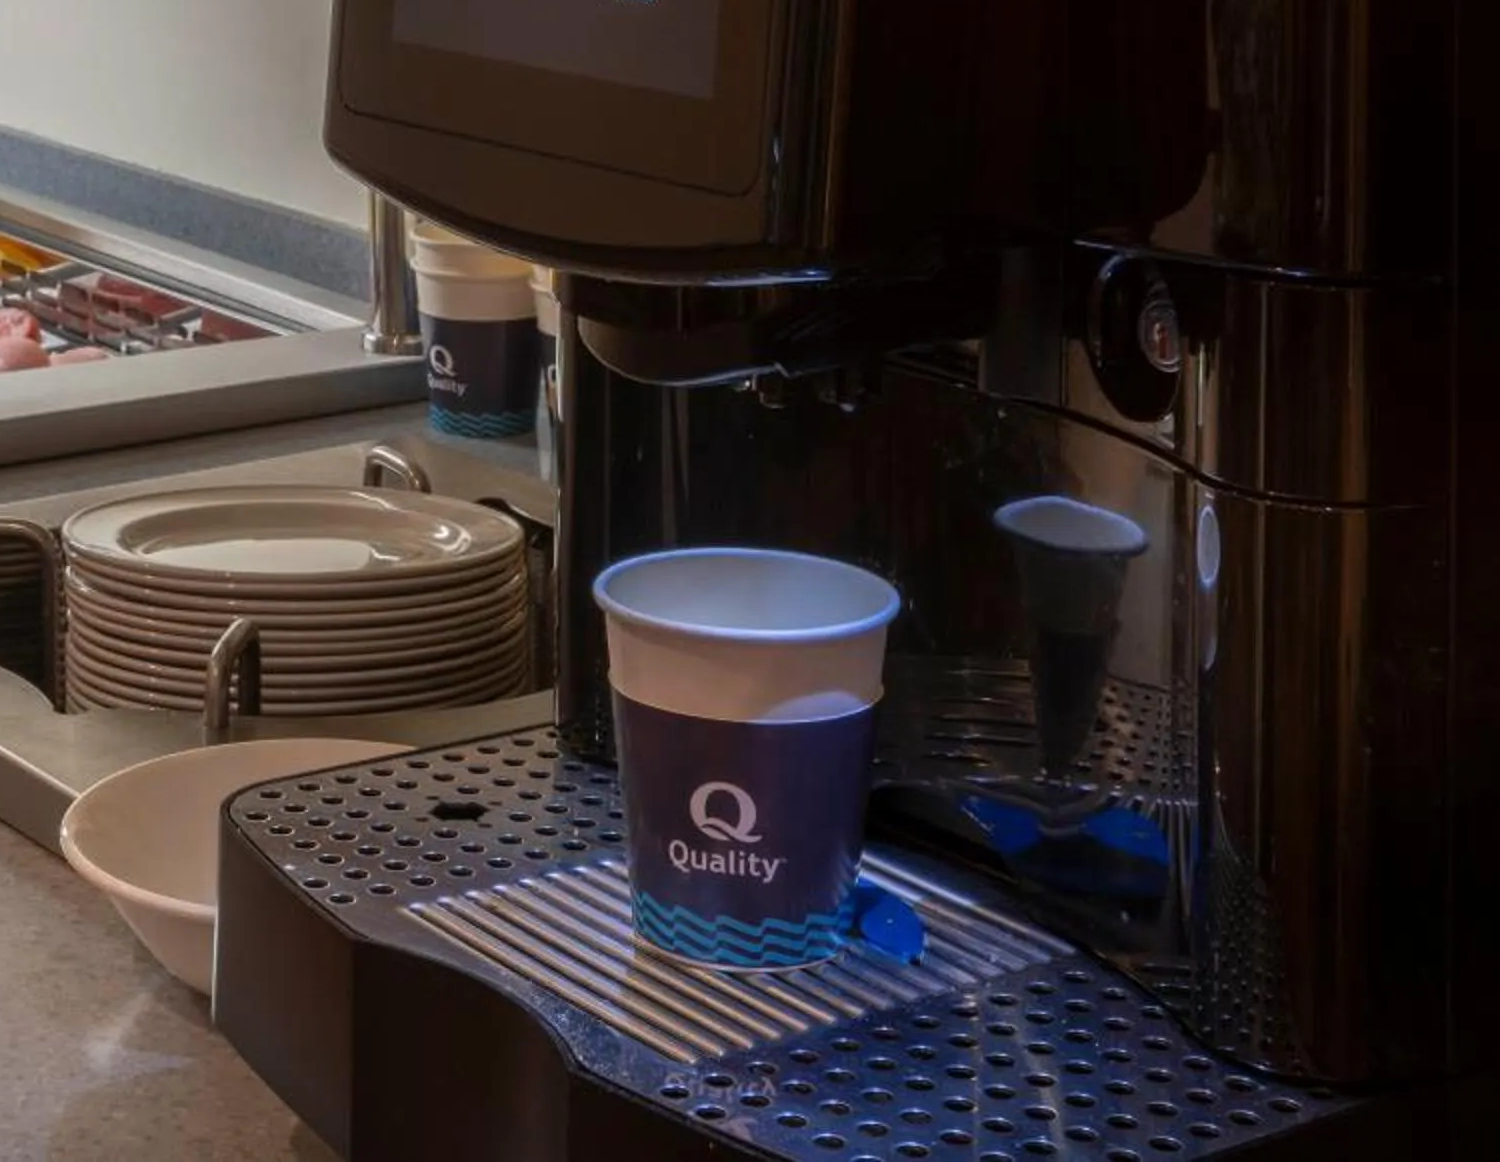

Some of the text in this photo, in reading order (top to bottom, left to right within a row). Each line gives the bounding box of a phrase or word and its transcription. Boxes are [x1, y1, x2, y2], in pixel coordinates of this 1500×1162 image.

[429, 345, 457, 377] Q
[690, 781, 762, 843] Q
[669, 840, 780, 883] Quality
